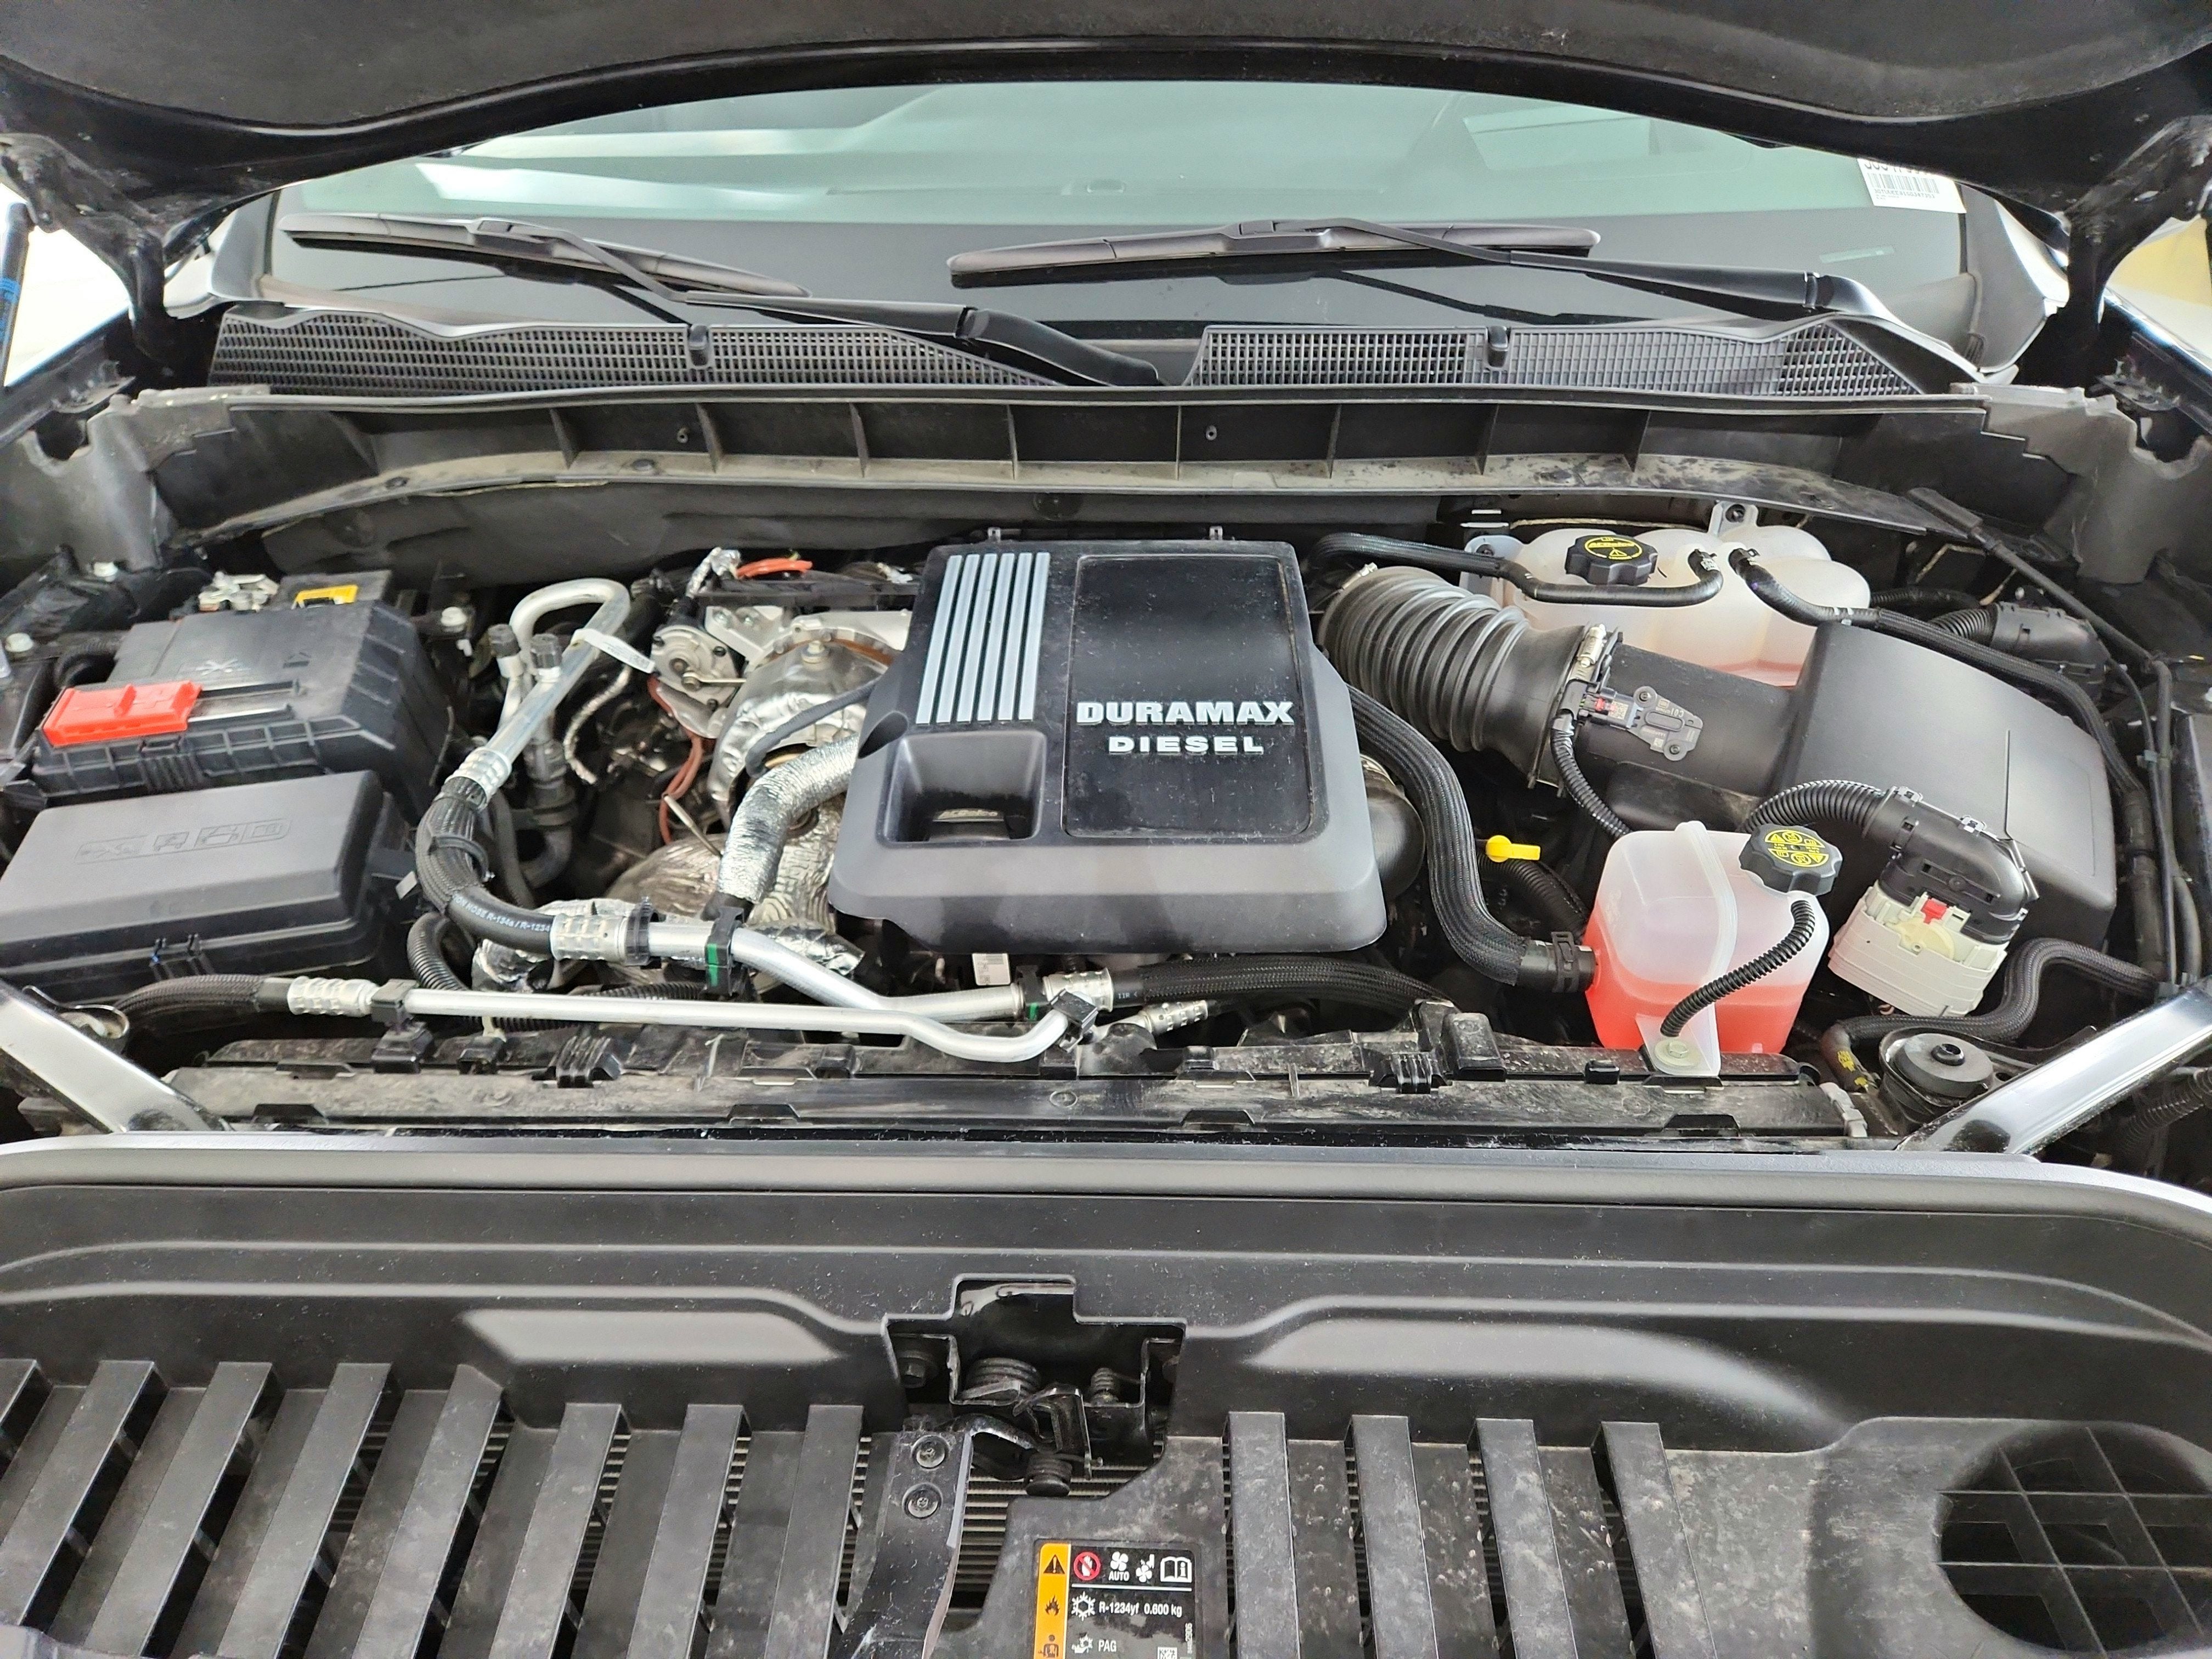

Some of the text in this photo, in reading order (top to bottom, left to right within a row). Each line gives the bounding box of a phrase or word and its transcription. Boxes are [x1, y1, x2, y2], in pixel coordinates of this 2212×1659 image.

[1076, 702, 1294, 725] DURAMAX
[1109, 736, 1264, 754] DIESEL
[465, 904, 486, 918] HOSE
[1108, 1571, 1130, 1581] AUTO
[1099, 1601, 1139, 1616] R-1234yf
[1171, 1604, 1182, 1617] kg
[1098, 1639, 1116, 1652] PAG
